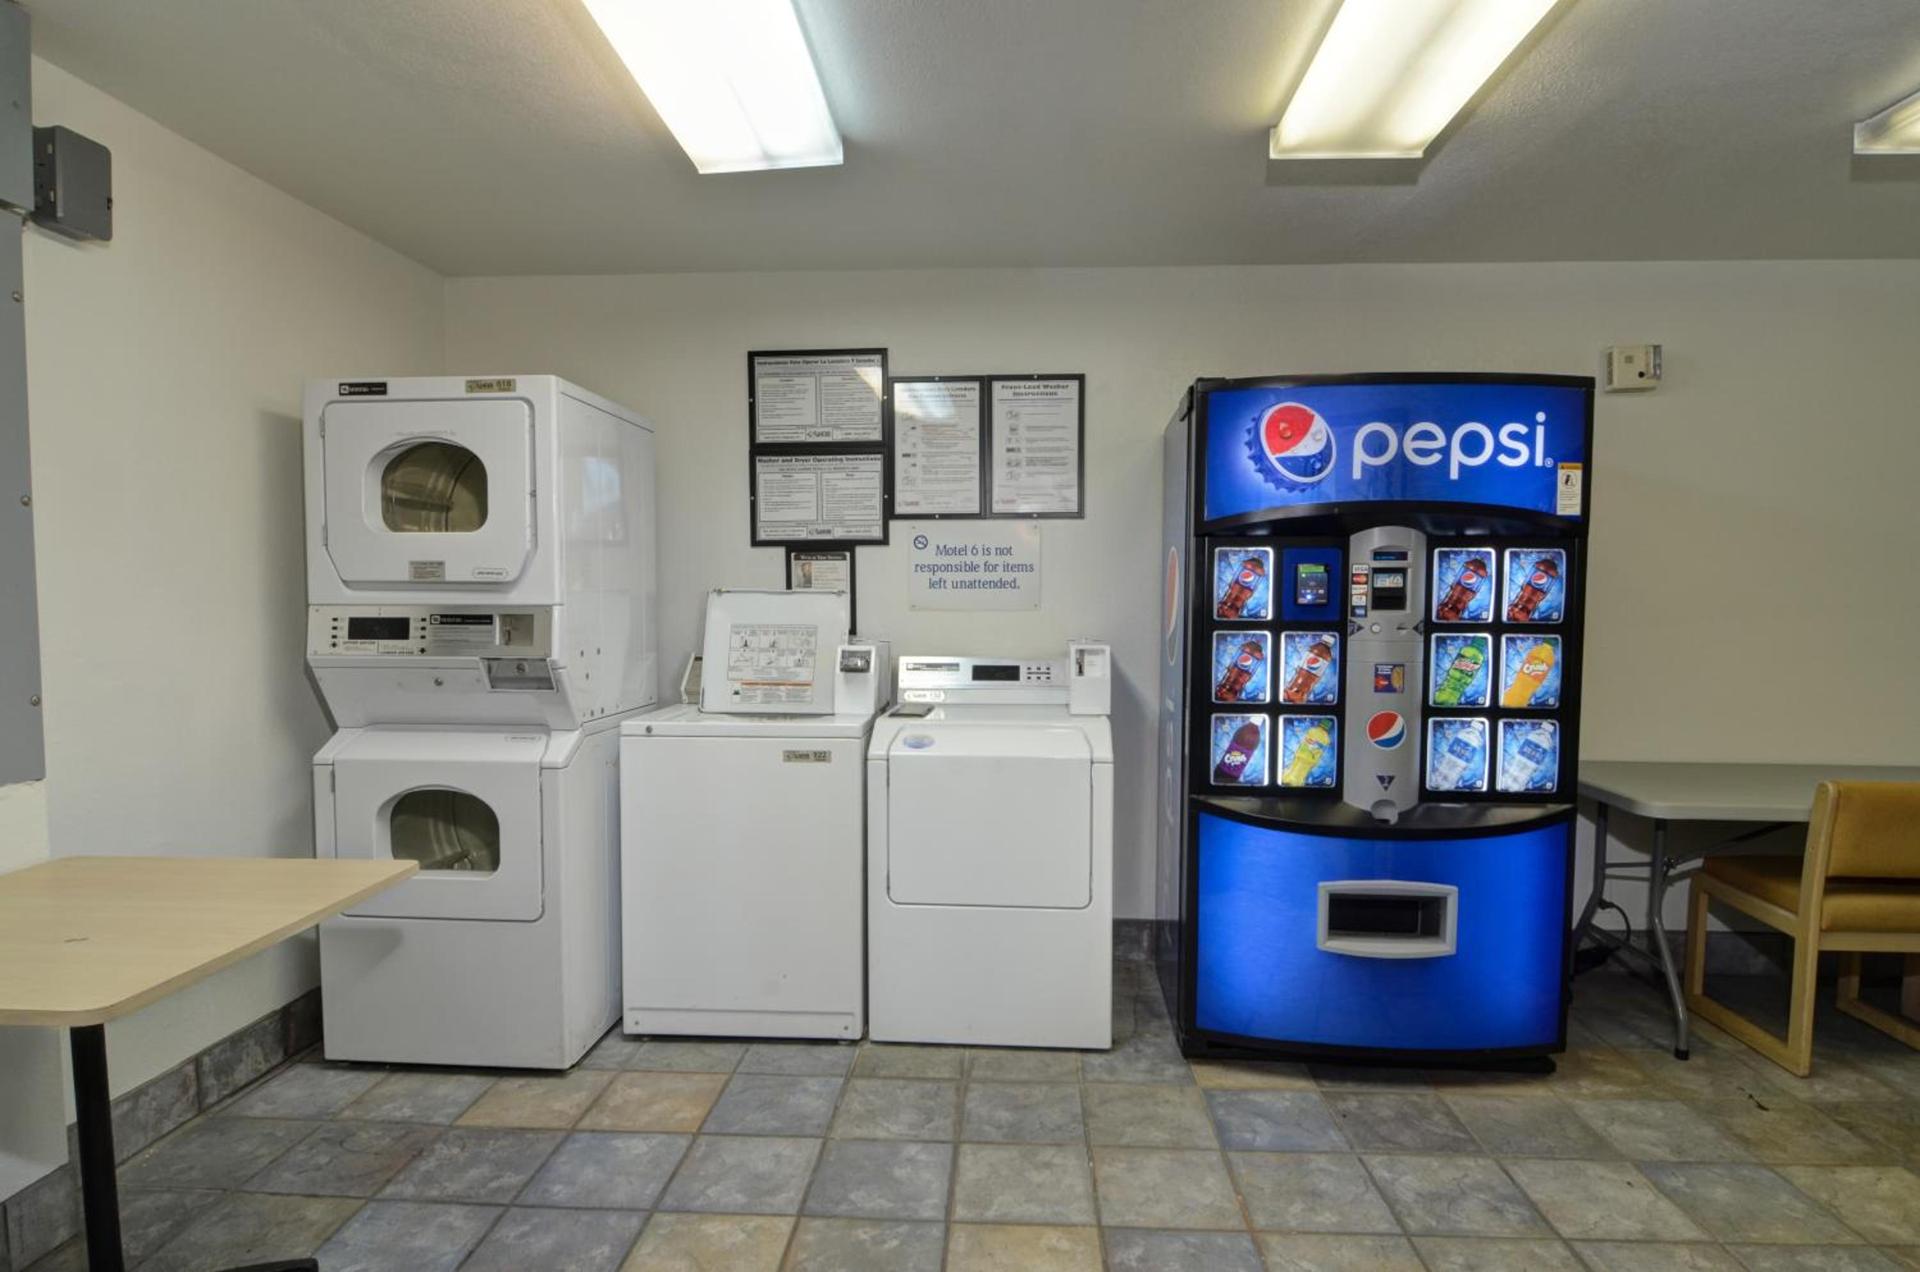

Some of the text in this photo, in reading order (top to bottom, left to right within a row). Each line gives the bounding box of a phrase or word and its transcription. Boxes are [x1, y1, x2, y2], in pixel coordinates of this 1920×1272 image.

[1352, 411, 1546, 480] pepsi
[935, 544, 1014, 557] Motel 6 is not
[914, 561, 1035, 576] responsible for items
[928, 578, 1021, 590] left unattended.
